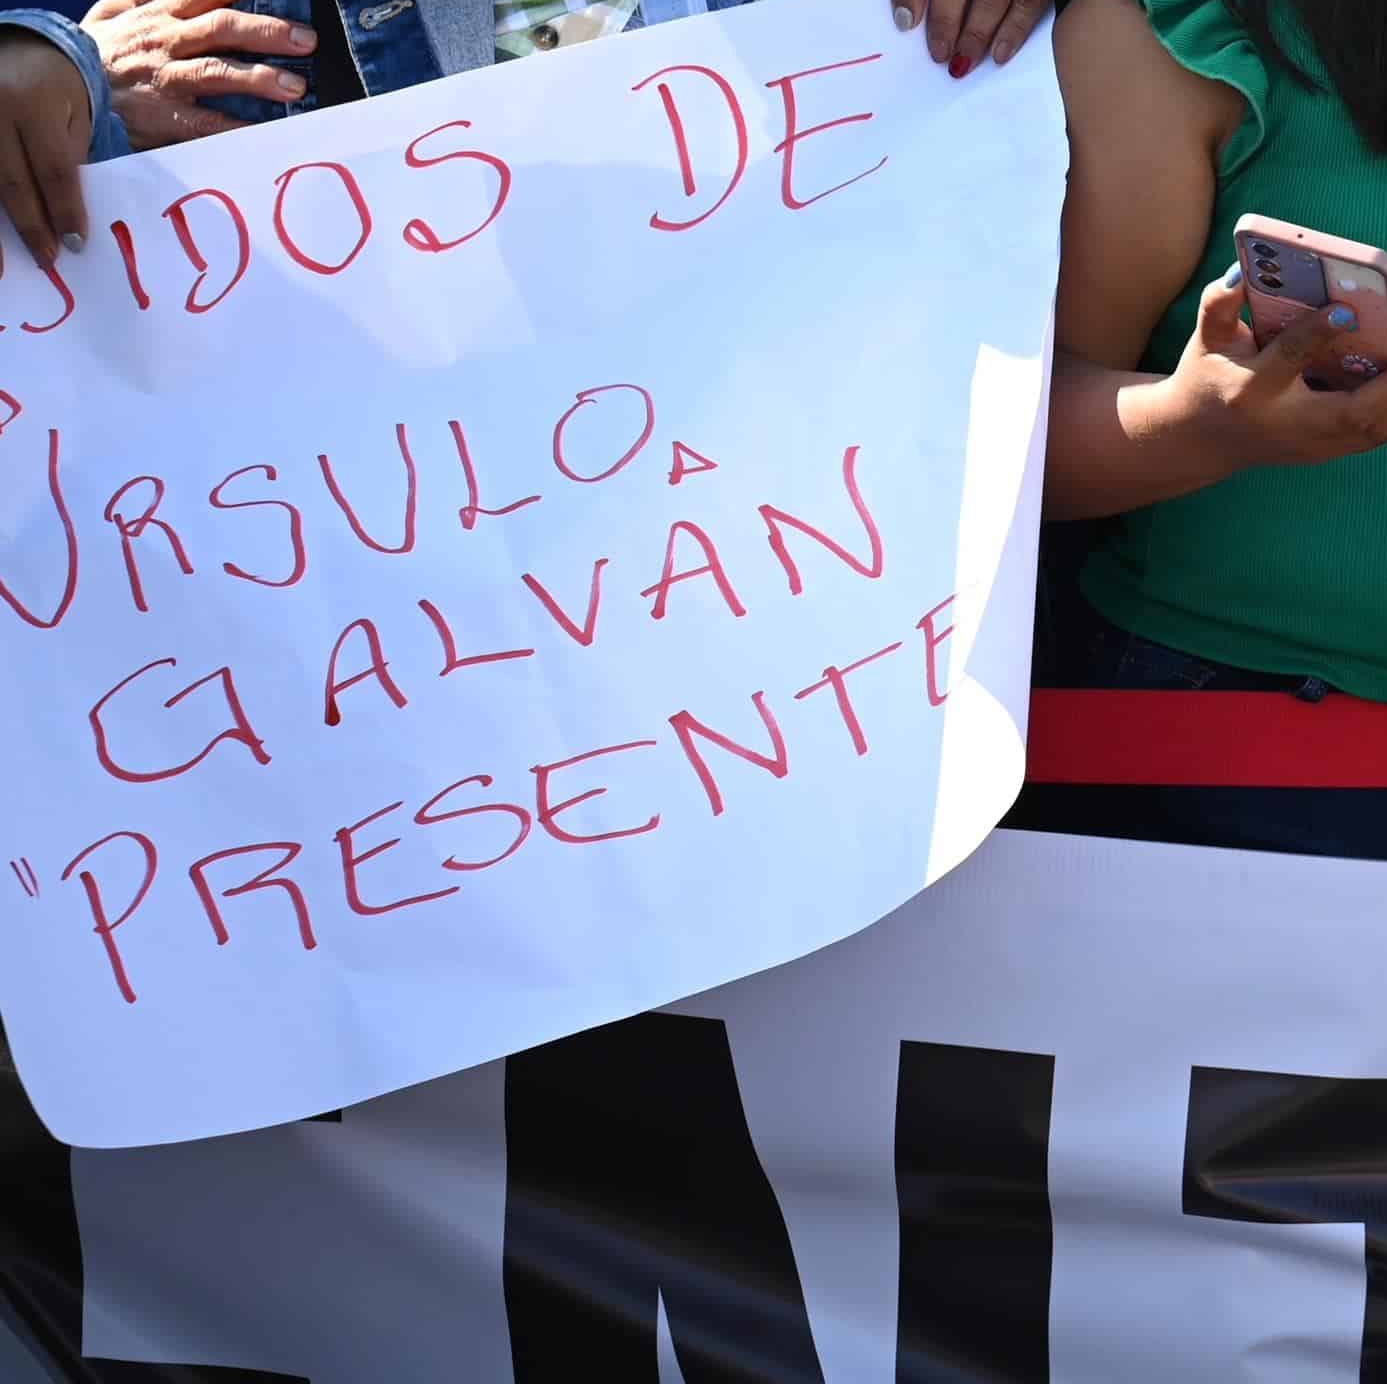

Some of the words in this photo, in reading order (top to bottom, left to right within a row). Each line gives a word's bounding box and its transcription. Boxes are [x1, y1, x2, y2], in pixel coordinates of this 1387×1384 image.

[0, 119, 512, 333] JIDOS
[631, 53, 890, 232] DE
[90, 445, 886, 782] GALVAN
